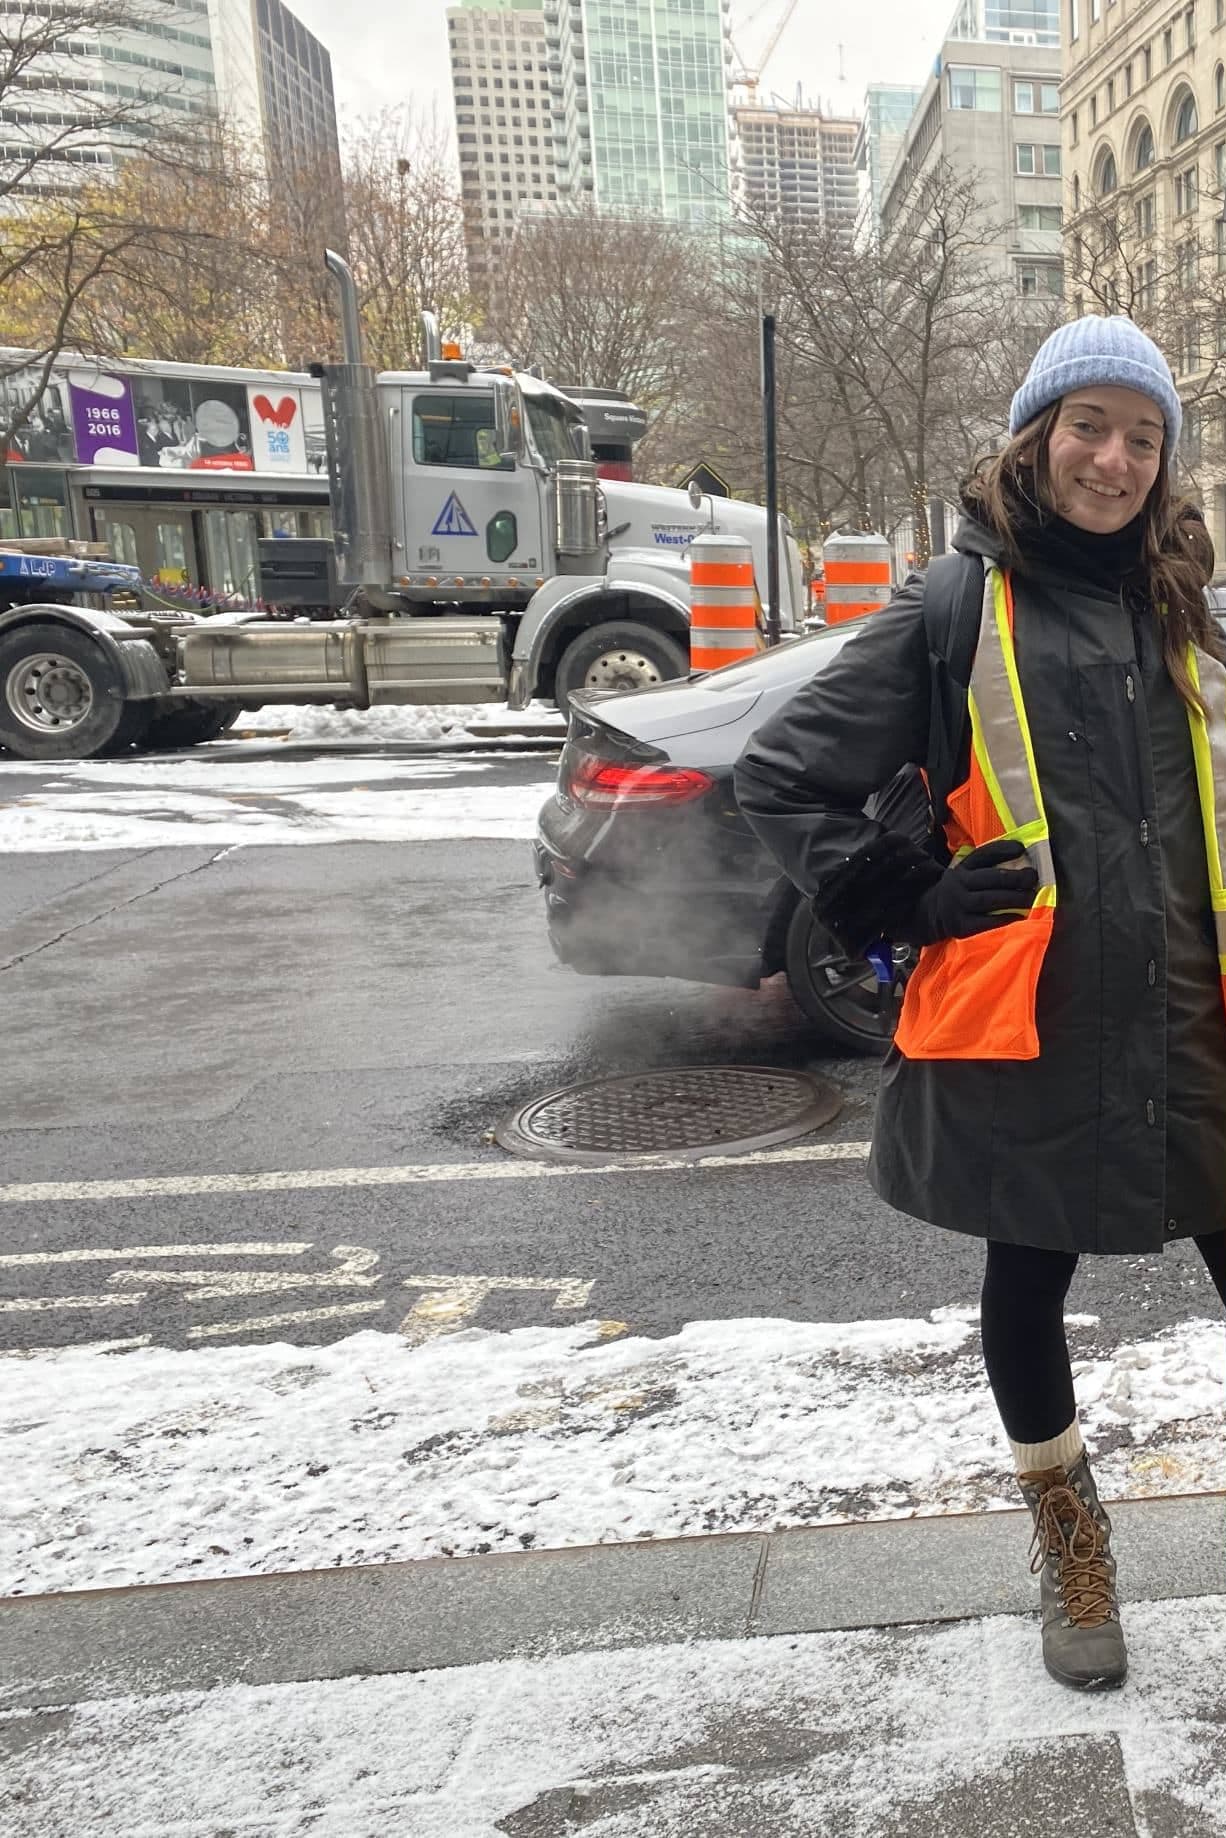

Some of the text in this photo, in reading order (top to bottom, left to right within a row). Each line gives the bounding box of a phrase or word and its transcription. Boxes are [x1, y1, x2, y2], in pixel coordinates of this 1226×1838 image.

[85, 407, 120, 420] 1966
[88, 423, 121, 436] 2016
[268, 442, 290, 453] ans
[30, 559, 56, 576] LJP
